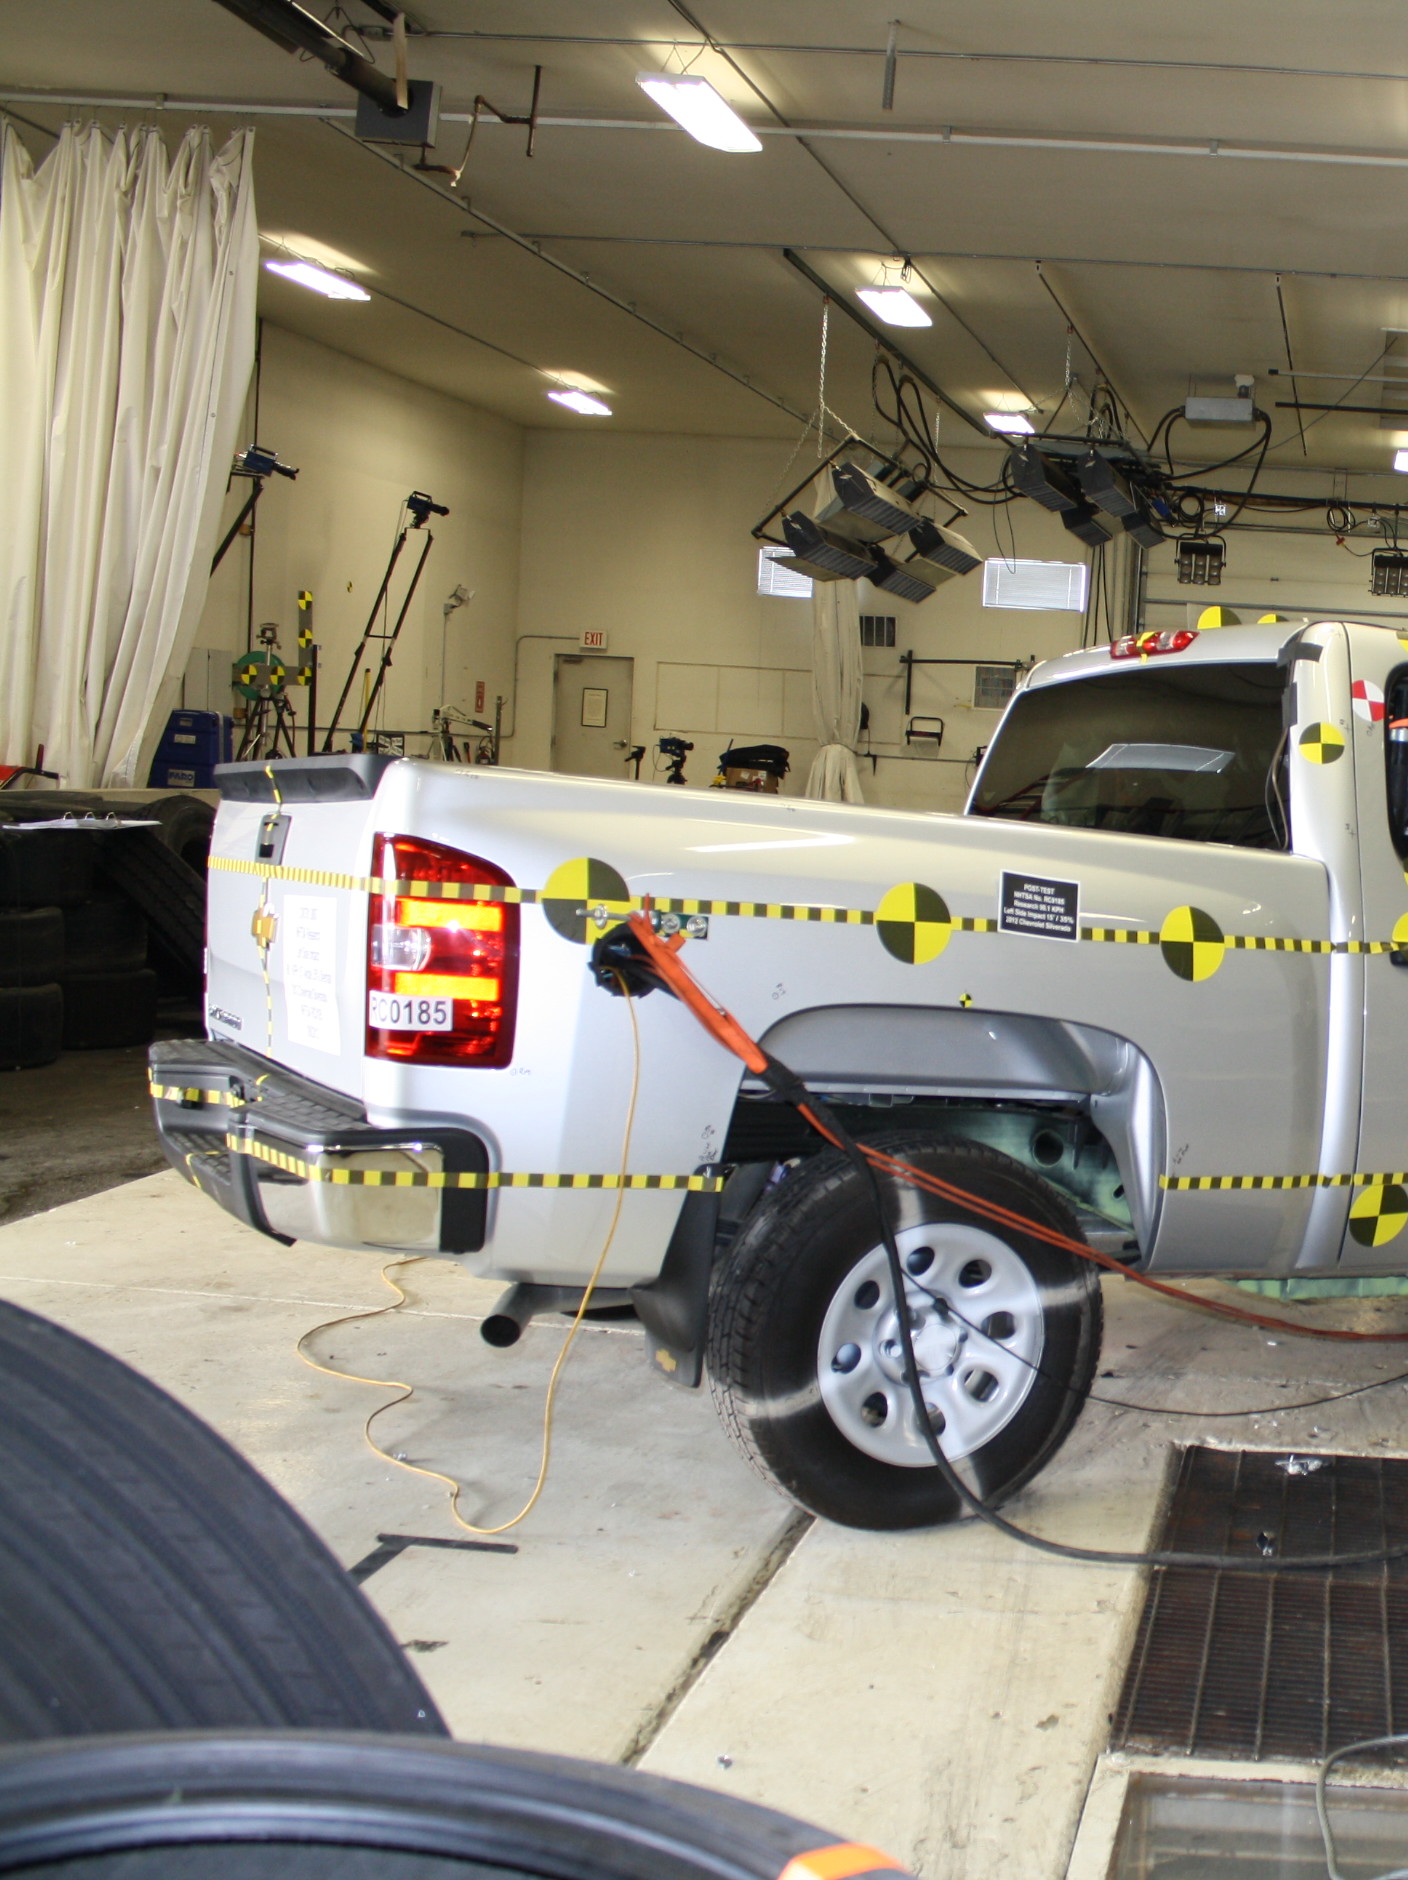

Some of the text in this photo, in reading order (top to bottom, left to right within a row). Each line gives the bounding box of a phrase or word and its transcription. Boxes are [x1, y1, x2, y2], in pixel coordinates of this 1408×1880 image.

[584, 631, 604, 646] EXIT
[1013, 890, 1033, 900] NHTSA
[1023, 883, 1055, 895] POST-TEST
[1003, 906, 1014, 915] Left
[1014, 908, 1027, 917] Side
[1027, 911, 1045, 920] Impact
[1013, 899, 1039, 910] Research
[1051, 905, 1064, 914] KPH
[1005, 915, 1071, 932] 2012 Chevrolet Silverado
[371, 996, 447, 1025] RC0185
